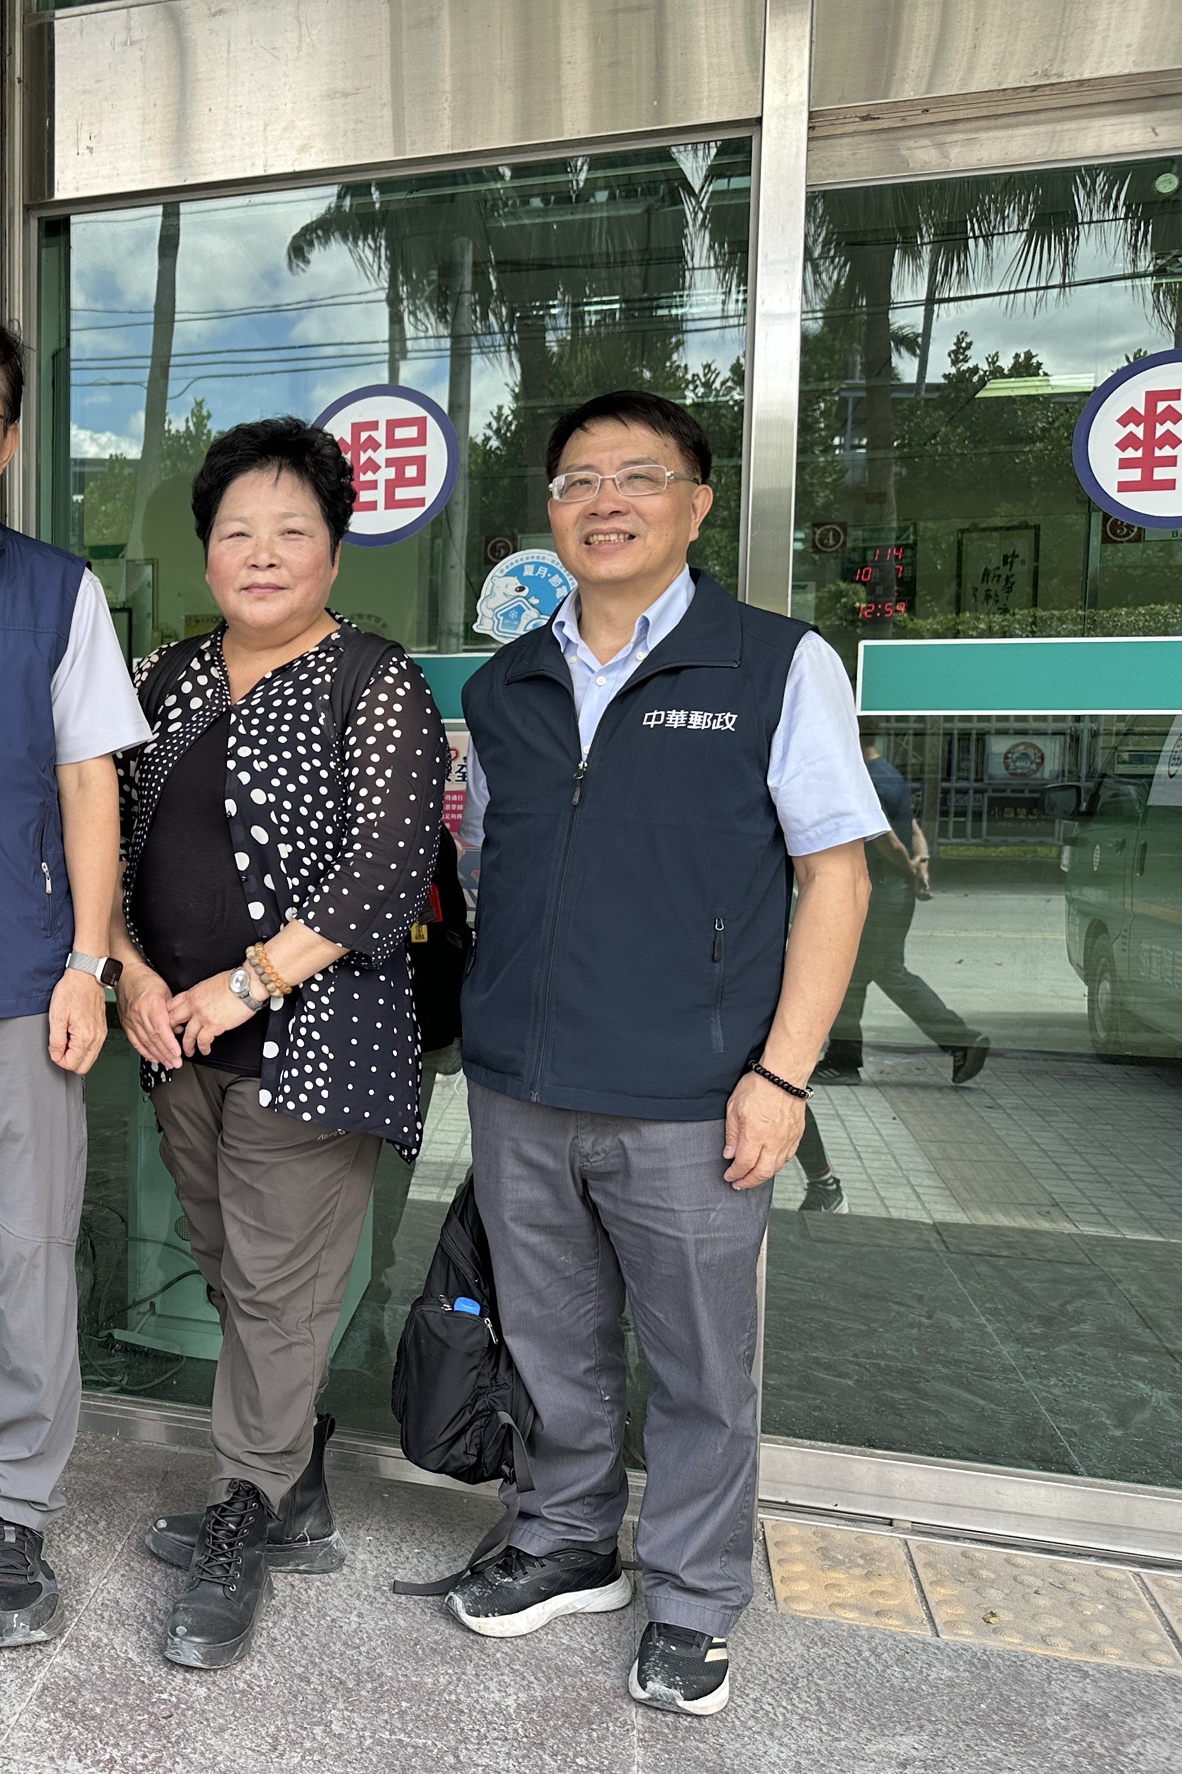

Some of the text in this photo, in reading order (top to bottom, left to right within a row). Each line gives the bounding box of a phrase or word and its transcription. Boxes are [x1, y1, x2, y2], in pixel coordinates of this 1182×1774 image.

[855, 566, 873, 582] 10
[895, 565, 903, 578] 7
[642, 709, 738, 731] 中華郵政
